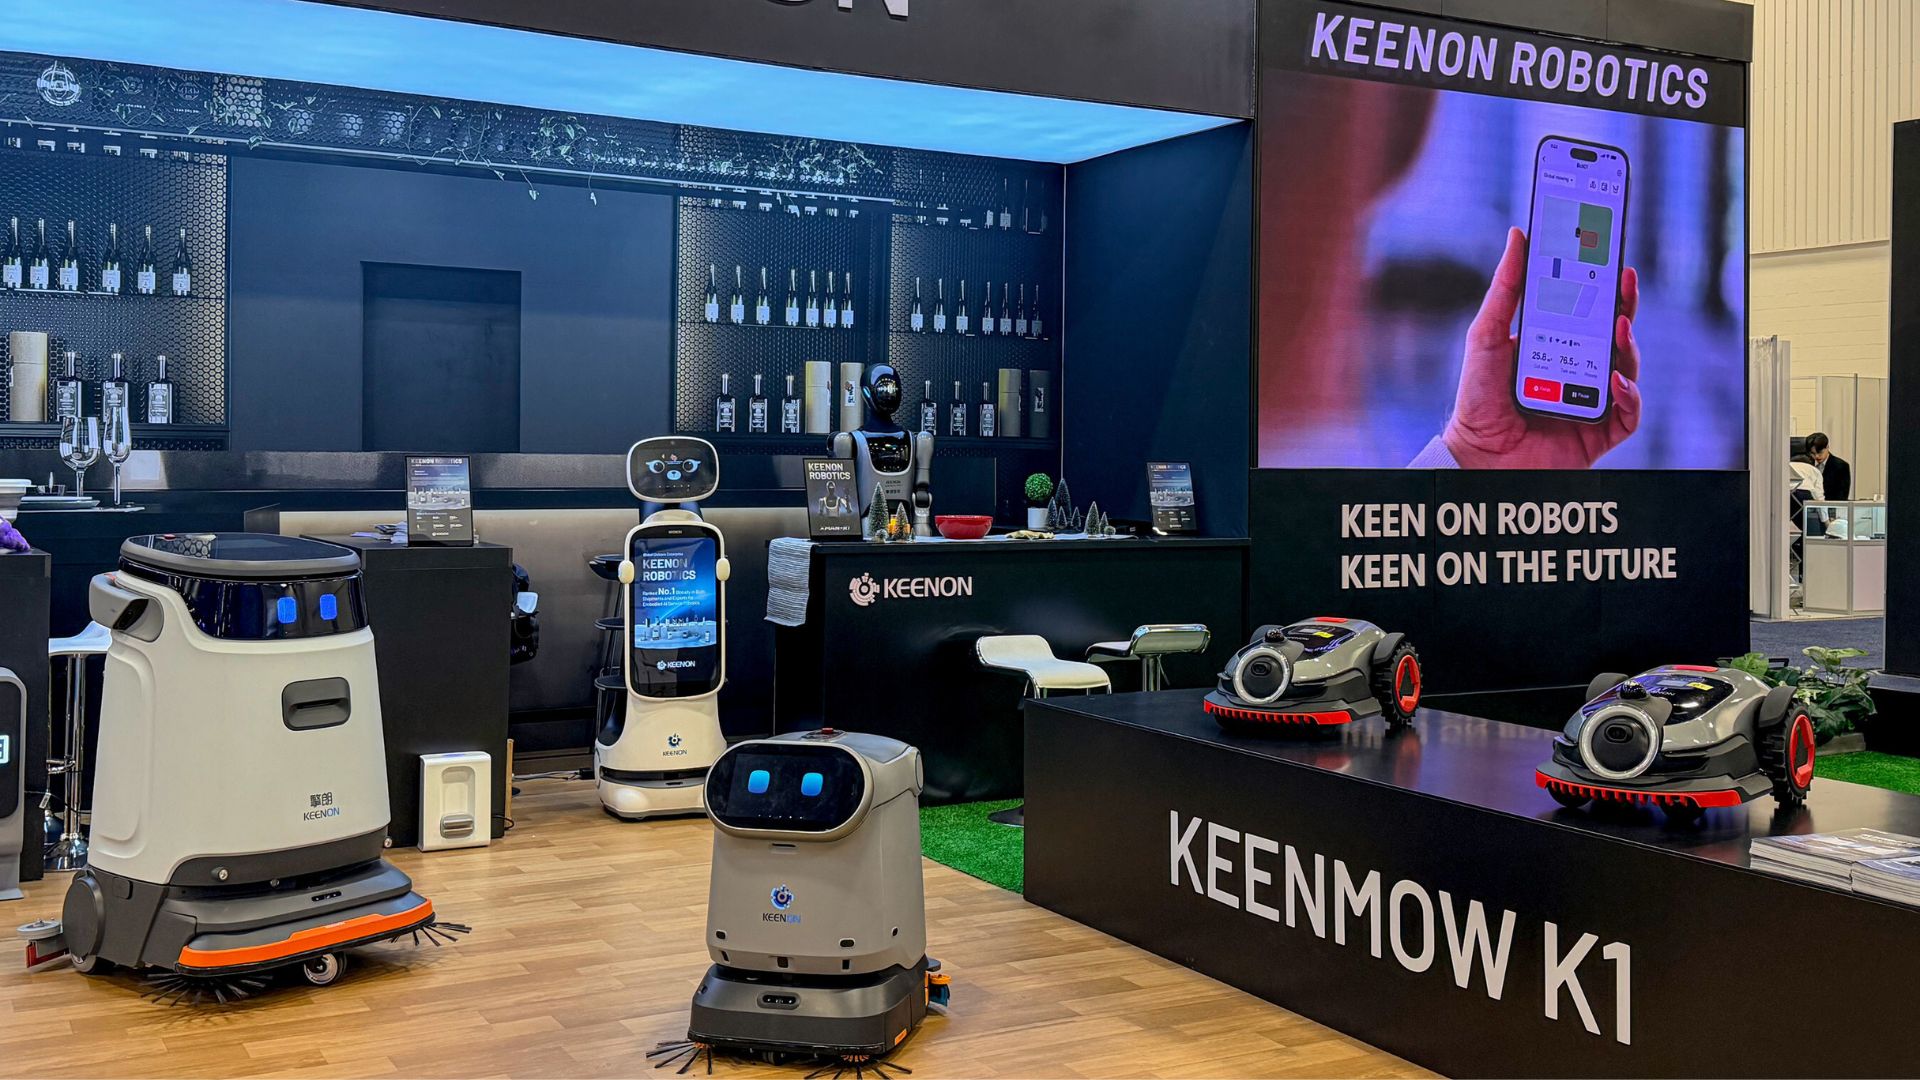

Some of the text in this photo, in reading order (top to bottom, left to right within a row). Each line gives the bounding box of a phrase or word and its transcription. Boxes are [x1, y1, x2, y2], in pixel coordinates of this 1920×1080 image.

[1311, 12, 1709, 108] KEENON ROBOTICS
[808, 463, 843, 472] KEENON
[809, 471, 851, 480] ROBOTICS
[1341, 501, 1619, 538] KEEN ON ROBOTS
[643, 559, 688, 569] KEENON
[1341, 547, 1677, 589] KEEN ON THE FUTURE
[658, 587, 675, 595] No.1
[883, 576, 973, 598] KEENON
[667, 660, 696, 668] KEENON
[303, 807, 340, 821] KEENON
[1170, 810, 1631, 1045] KEENMOW K1
